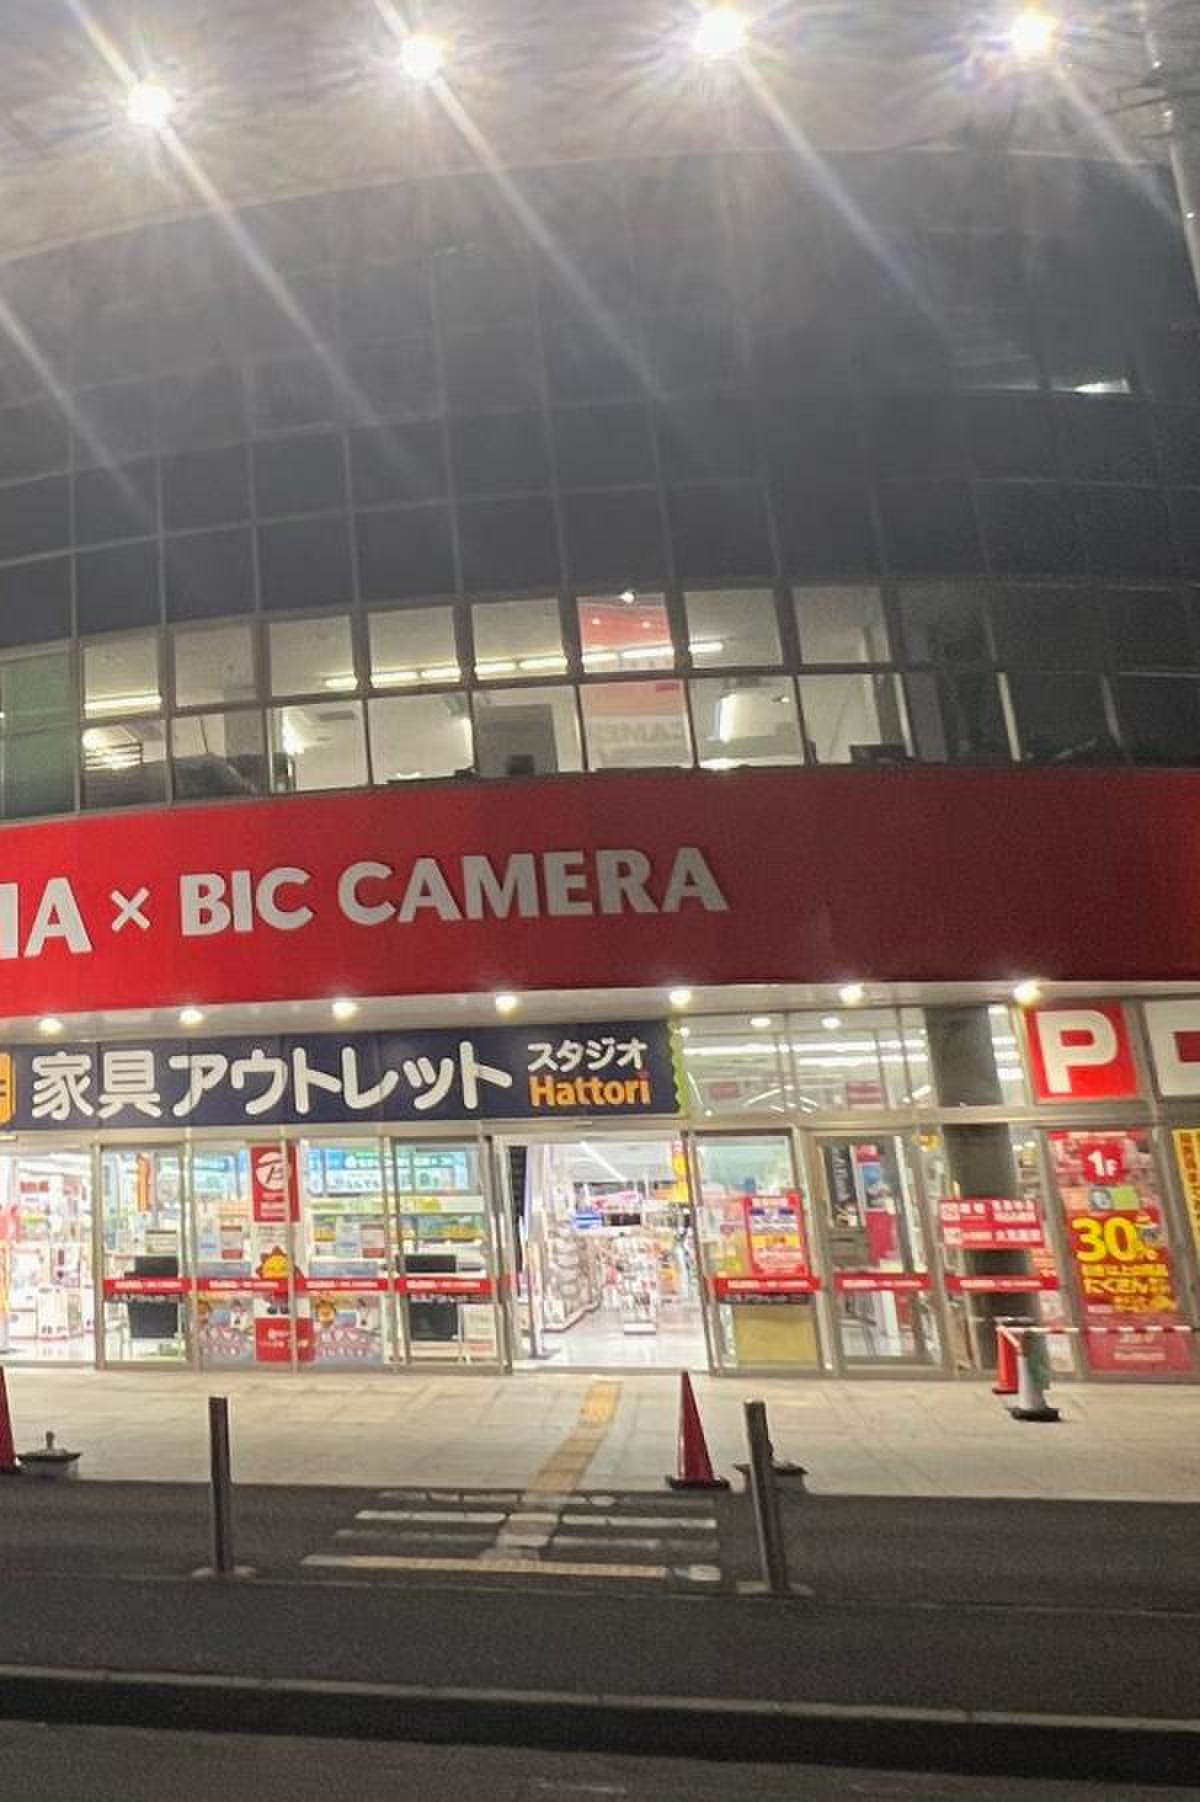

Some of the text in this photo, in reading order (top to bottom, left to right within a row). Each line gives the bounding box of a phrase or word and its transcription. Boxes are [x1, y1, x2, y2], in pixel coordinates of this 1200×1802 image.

[178, 866, 315, 938] BIC
[336, 847, 731, 927] CAMERA
[30, 1040, 513, 1121] 家具アウトレット
[527, 1037, 649, 1073] スタジオ
[528, 1071, 652, 1107] Hattori
[1035, 1008, 1119, 1094] P
